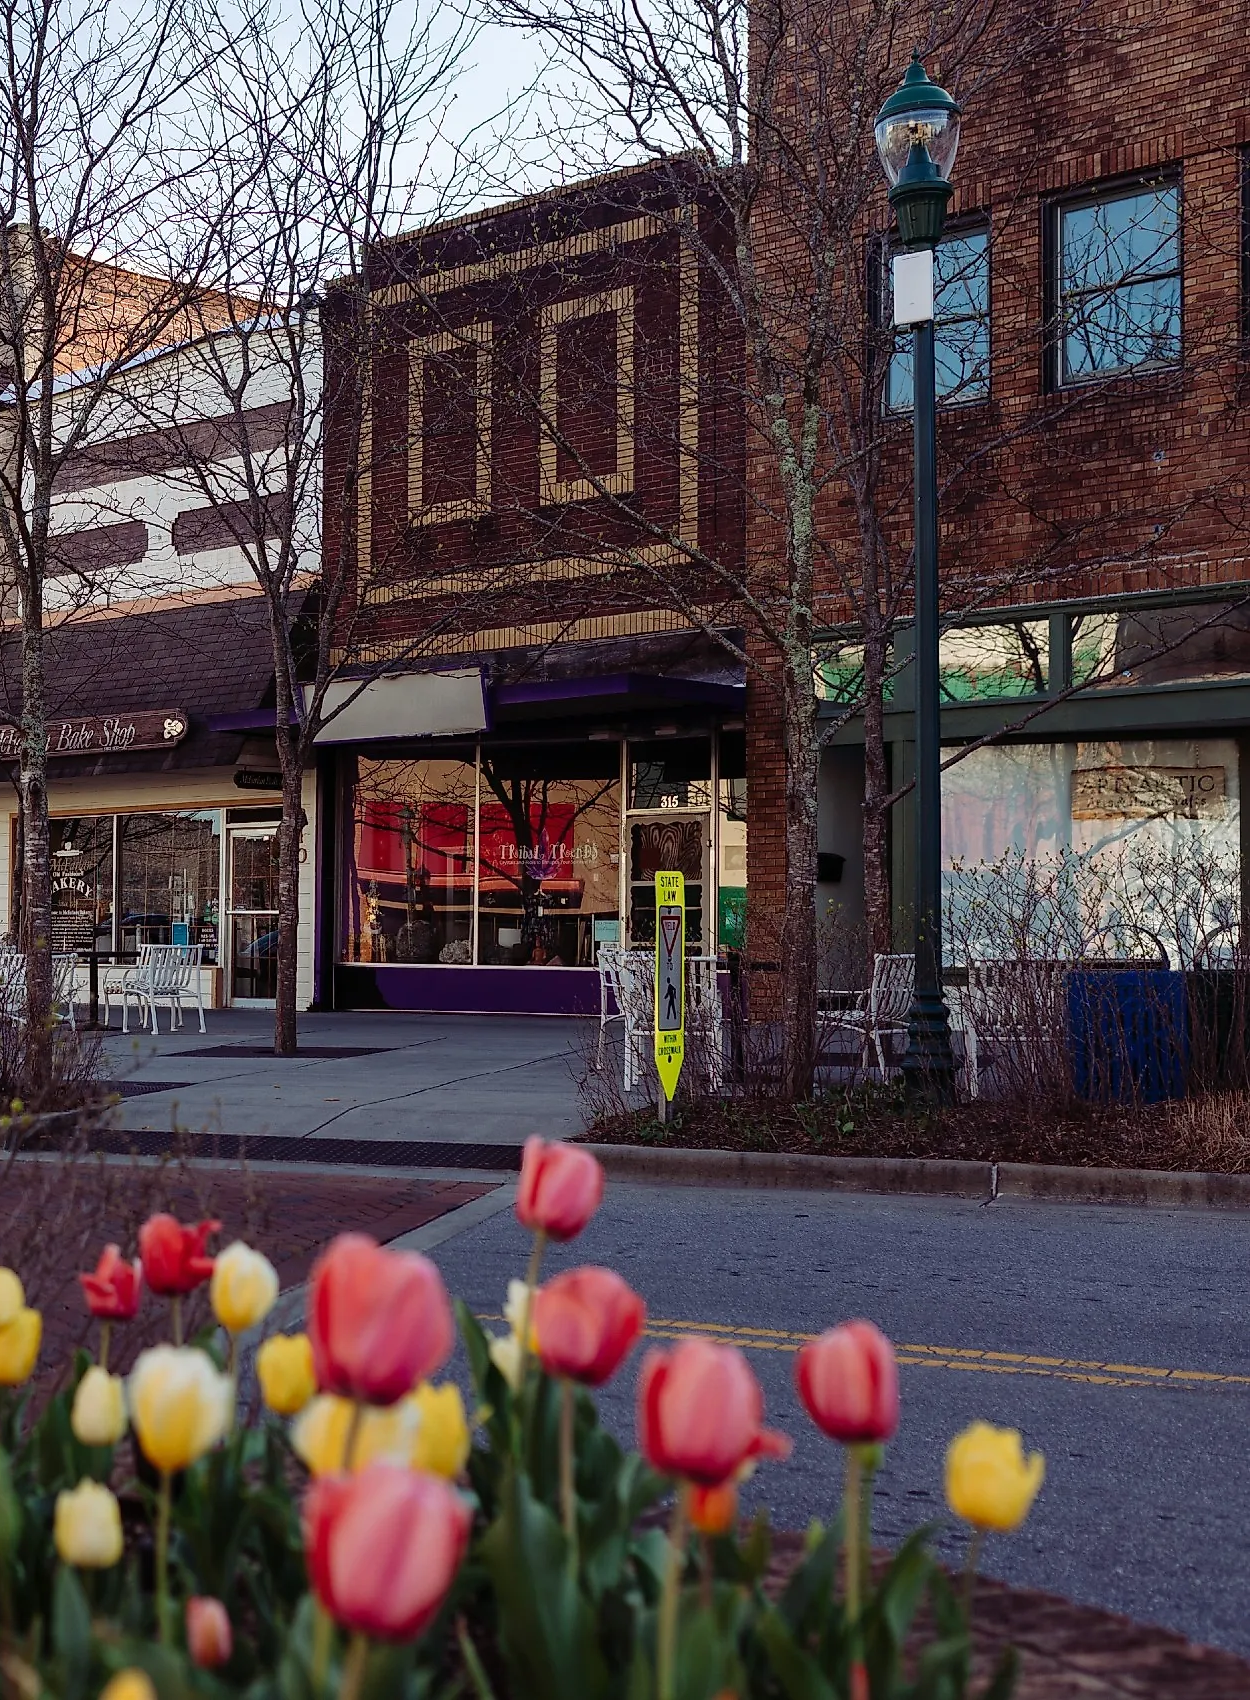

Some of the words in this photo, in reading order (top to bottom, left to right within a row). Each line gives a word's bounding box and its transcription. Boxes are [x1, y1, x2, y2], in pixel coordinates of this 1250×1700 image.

[55, 724, 94, 751] Bake
[100, 719, 136, 750] Shop
[660, 795, 679, 808] 315
[51, 876, 93, 898] AKERY
[660, 876, 679, 888] STATE
[663, 891, 677, 902] LAW
